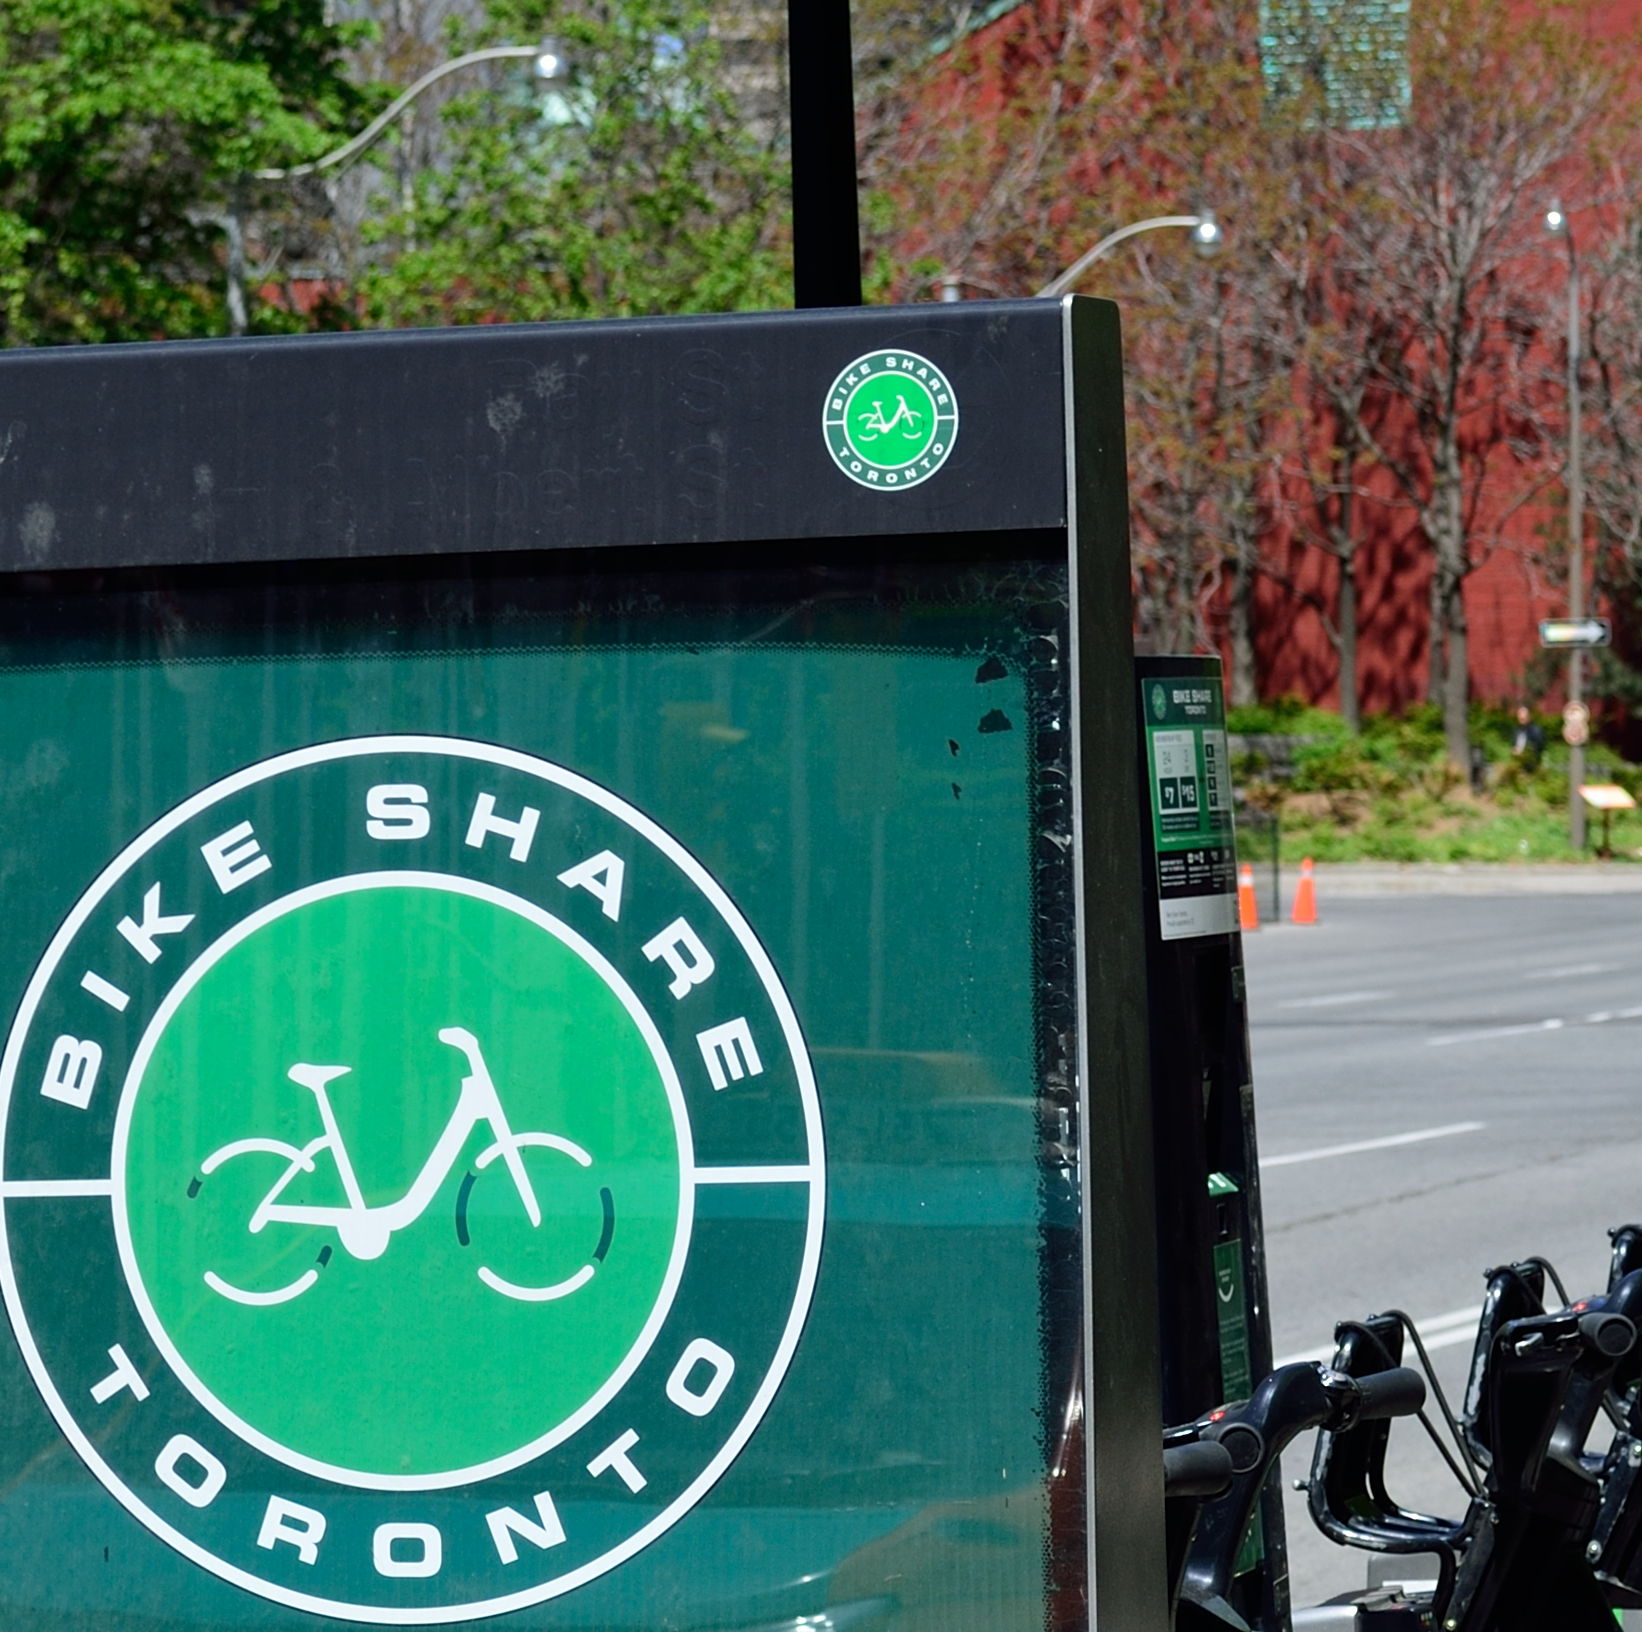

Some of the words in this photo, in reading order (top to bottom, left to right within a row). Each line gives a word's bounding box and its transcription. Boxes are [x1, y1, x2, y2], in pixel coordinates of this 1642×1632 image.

[832, 363, 871, 410] BIKE
[886, 356, 949, 405] SHARE
[839, 443, 944, 484] TORONTO
[1172, 689, 1191, 704] BIKE
[1192, 689, 1212, 703] SHARE
[41, 820, 272, 1110] BIKE
[366, 783, 763, 1091] SHARE
[90, 1337, 735, 1578] TORONTO
